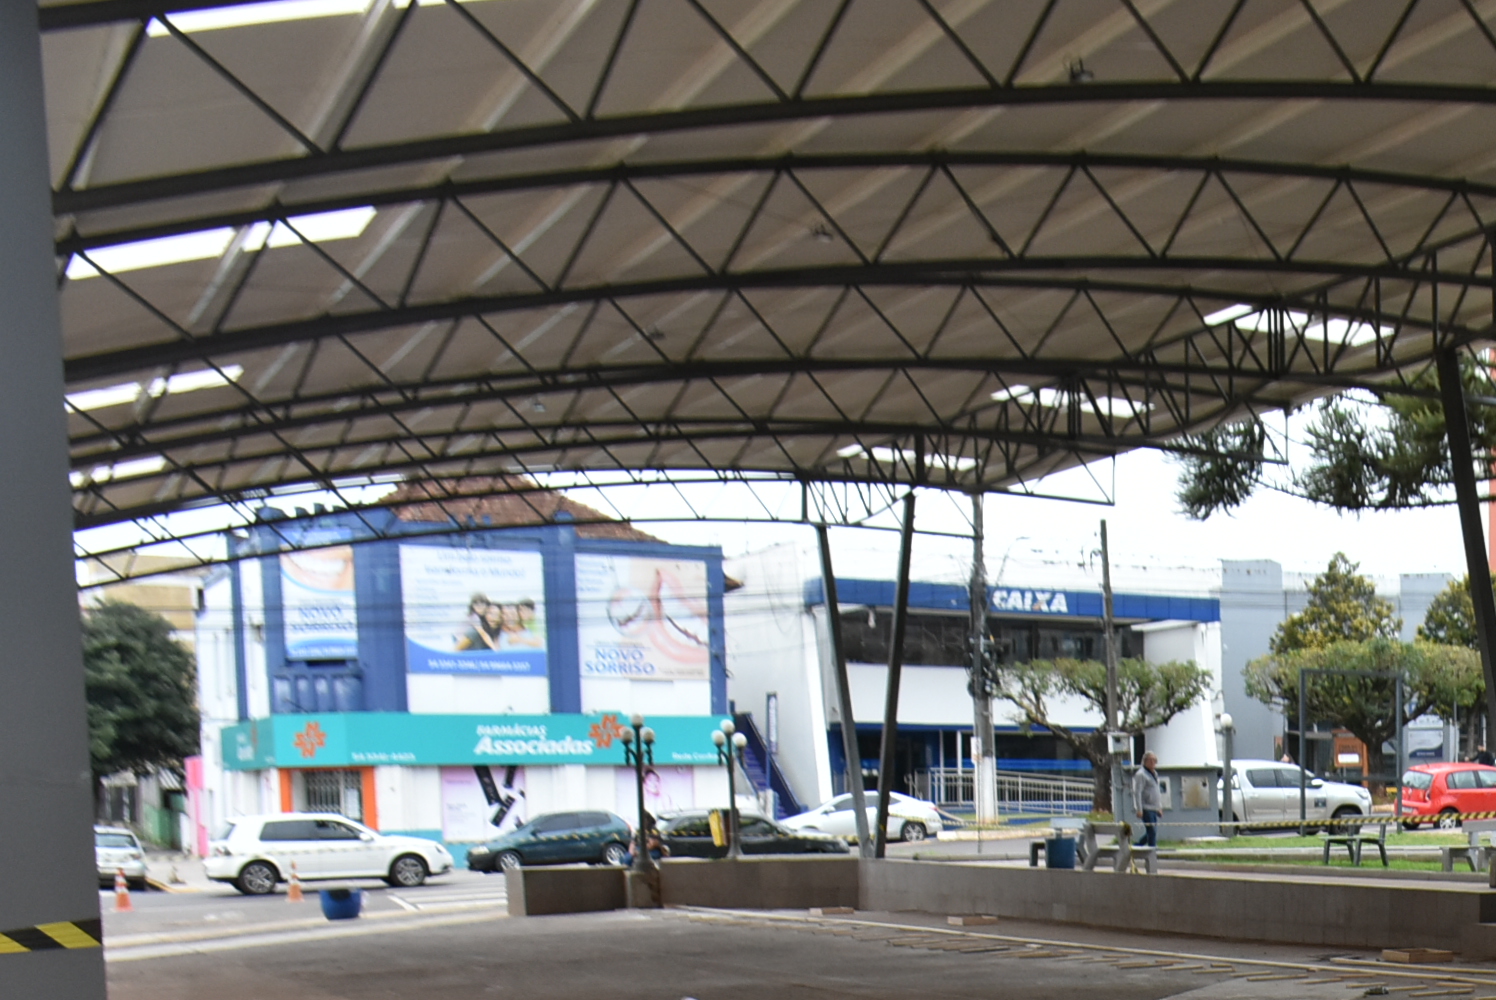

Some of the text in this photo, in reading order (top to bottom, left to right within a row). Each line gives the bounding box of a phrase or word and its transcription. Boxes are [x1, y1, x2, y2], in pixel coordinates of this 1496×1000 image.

[992, 589, 1069, 613] CAIXA
[594, 648, 645, 661] NOVO
[585, 661, 655, 675] SORRISO
[473, 734, 594, 755] Associadas
